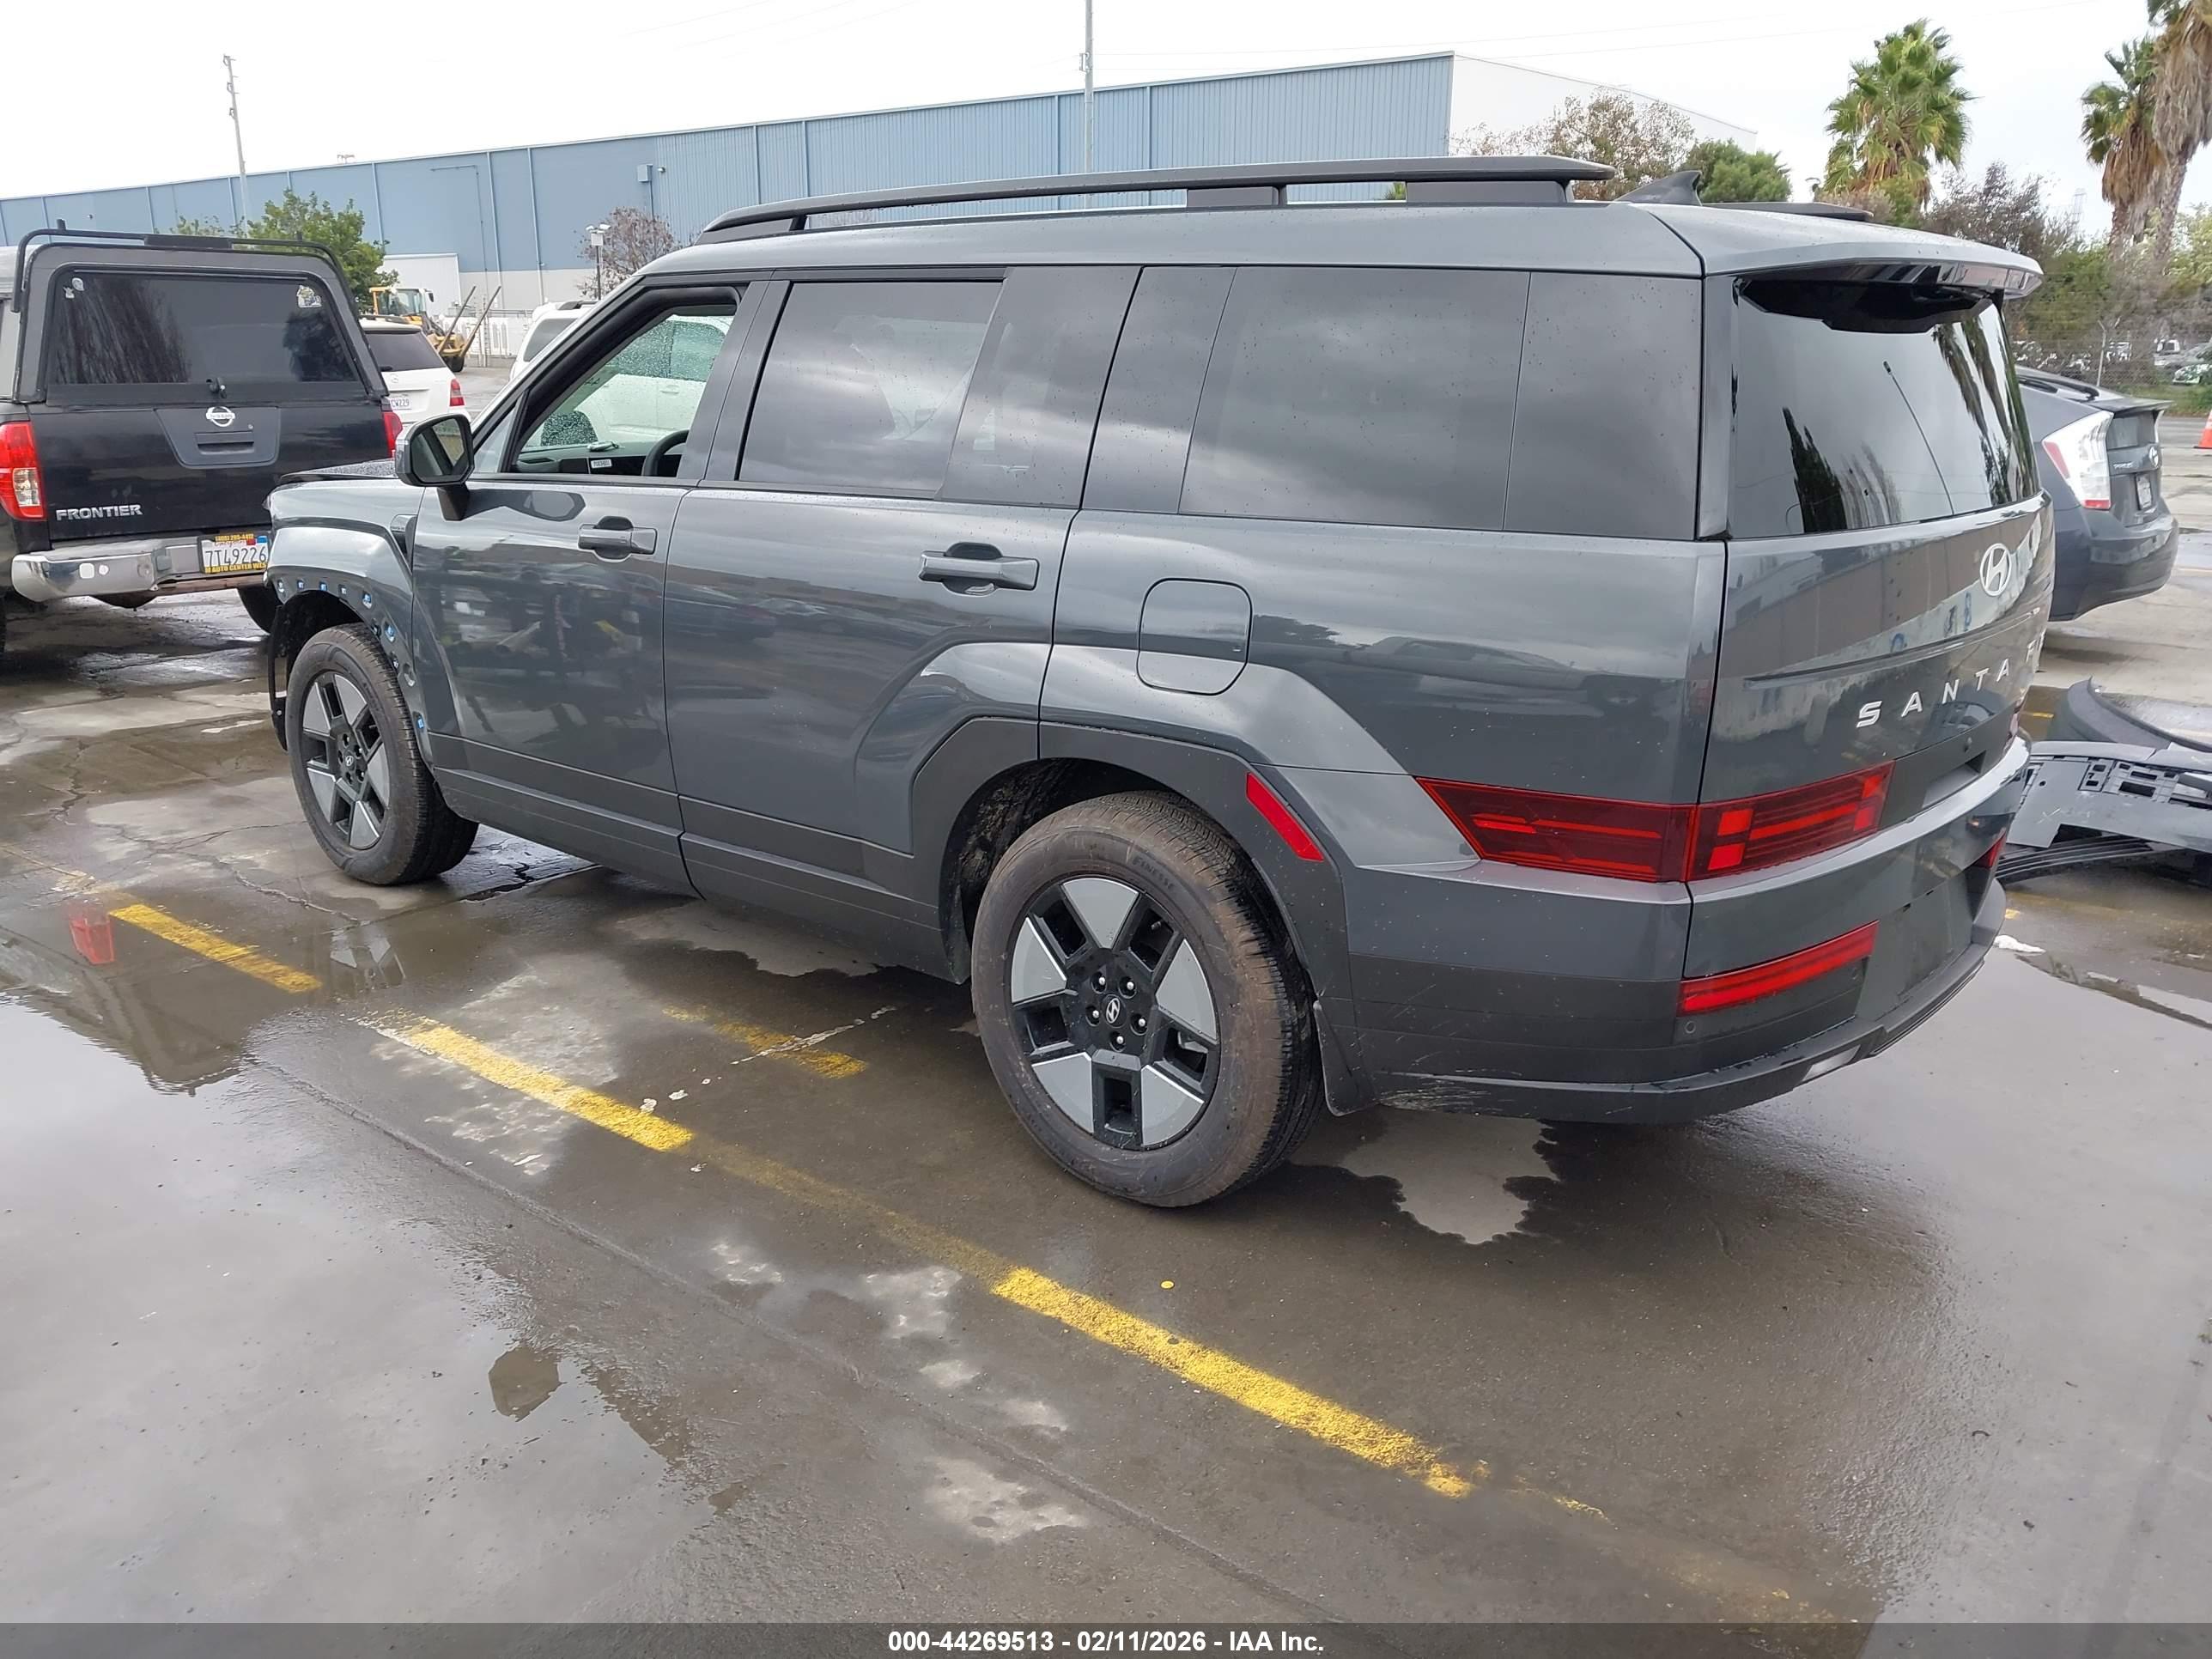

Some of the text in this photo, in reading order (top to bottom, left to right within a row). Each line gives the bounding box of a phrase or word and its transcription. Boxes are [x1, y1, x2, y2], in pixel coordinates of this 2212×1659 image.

[56, 504, 143, 520] FRONTIER
[205, 546, 267, 568] 7T49226
[1856, 658, 2010, 728] SANTA
